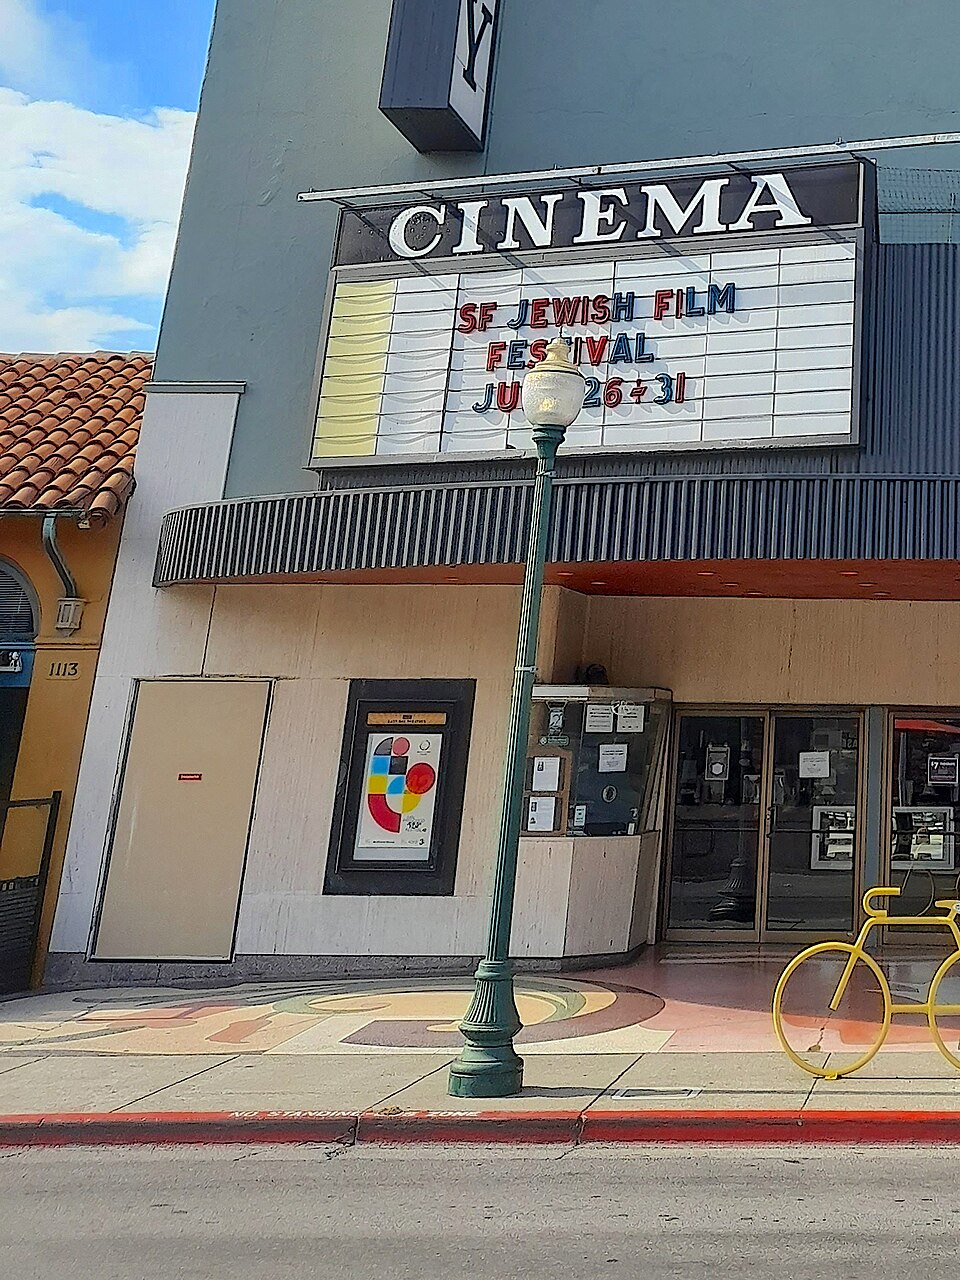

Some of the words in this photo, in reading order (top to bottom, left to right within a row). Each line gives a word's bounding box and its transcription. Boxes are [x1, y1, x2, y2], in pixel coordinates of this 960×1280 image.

[388, 172, 811, 258] CINEMA
[458, 302, 497, 334] SF
[507, 292, 634, 329] JEWISH
[653, 283, 735, 320] FILM
[49, 662, 78, 677] 1113
[229, 1110, 259, 1118] NO
